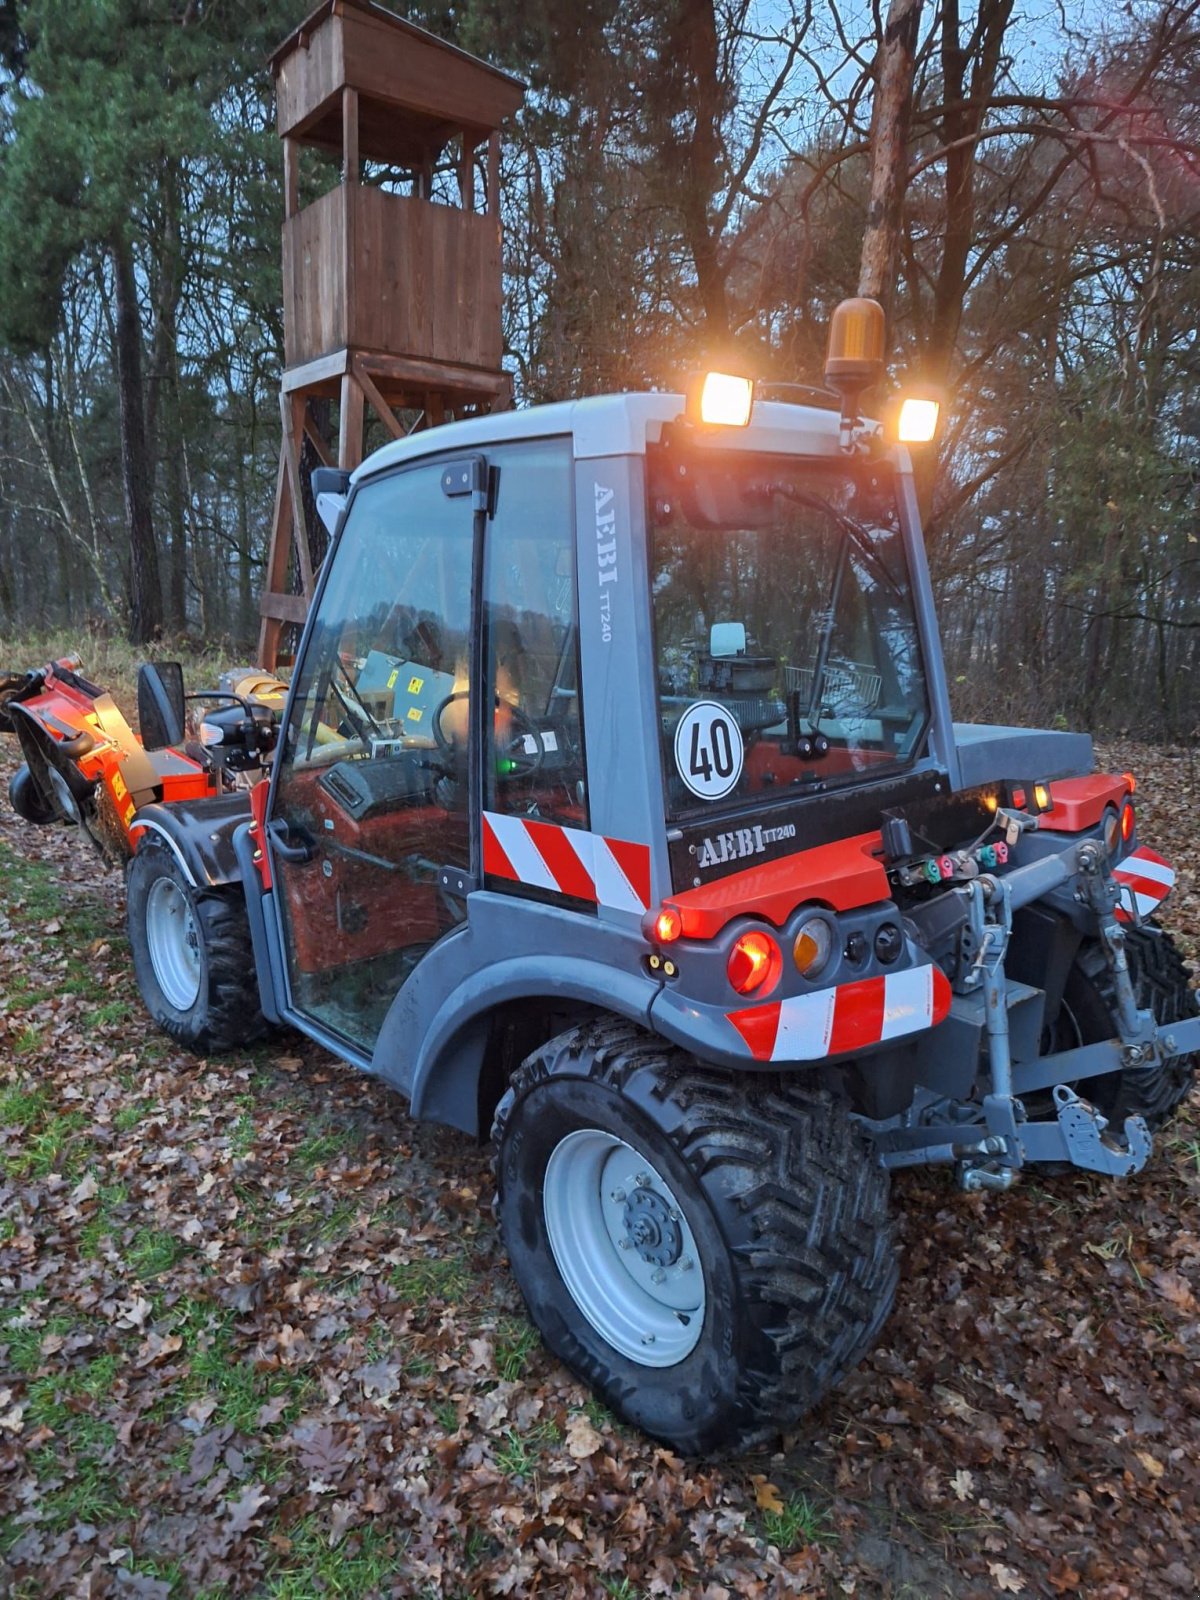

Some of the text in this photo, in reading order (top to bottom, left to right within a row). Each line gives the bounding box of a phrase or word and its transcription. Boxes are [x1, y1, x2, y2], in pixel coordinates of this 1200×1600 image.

[594, 481, 618, 643] AEBI TT240
[689, 718, 734, 782] 40
[699, 823, 796, 868] AEBI TT240
